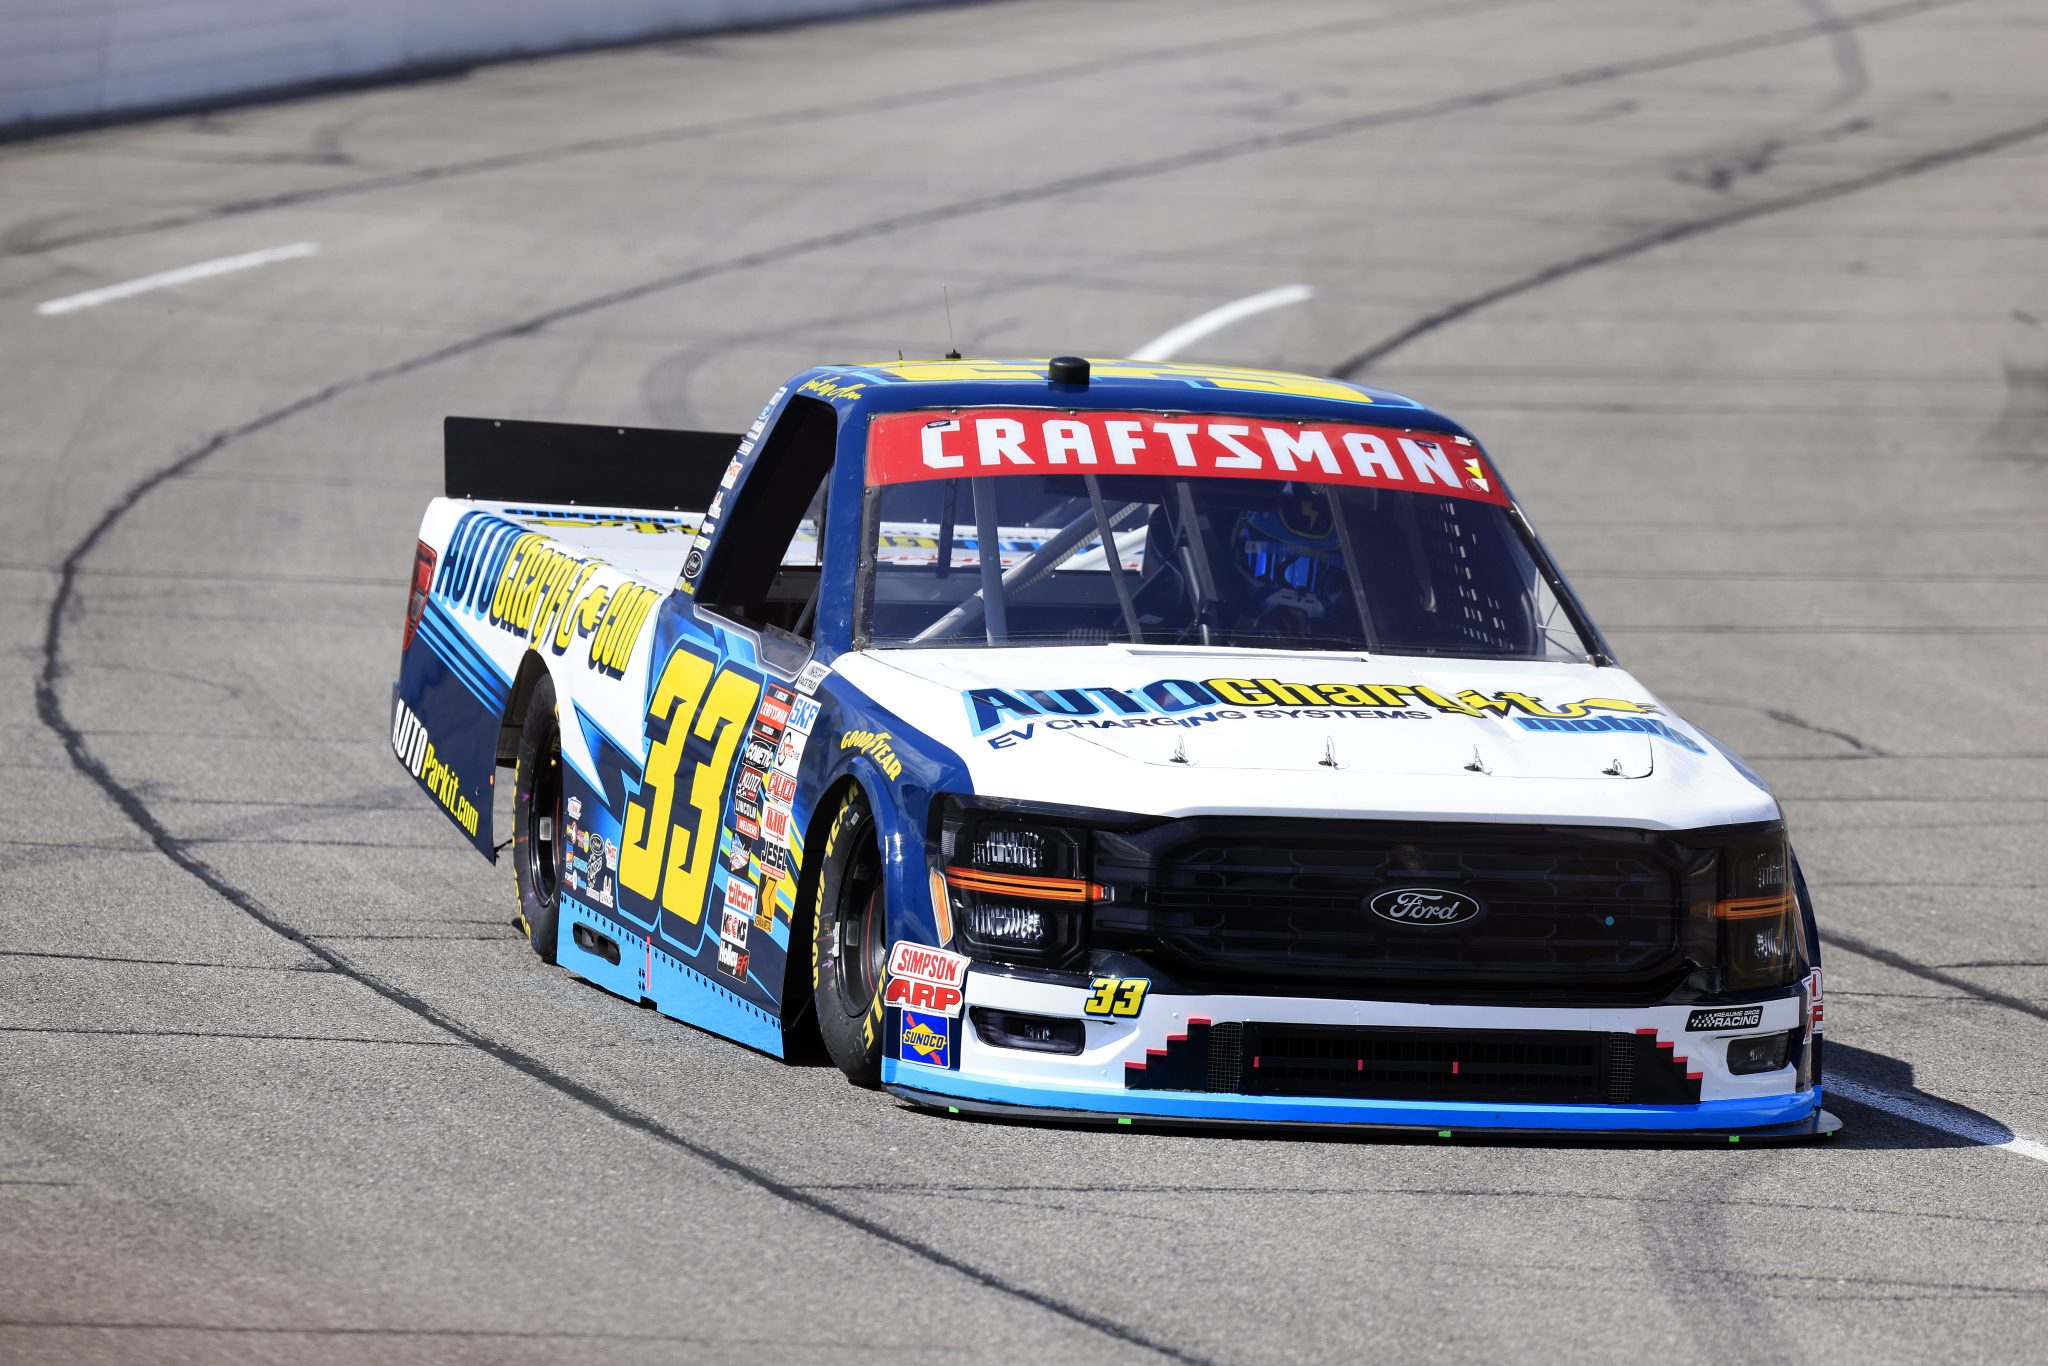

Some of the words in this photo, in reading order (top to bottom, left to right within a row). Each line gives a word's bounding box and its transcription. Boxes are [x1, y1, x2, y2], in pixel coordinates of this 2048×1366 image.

[921, 418, 1463, 488] CRAFTSMAN
[788, 698, 820, 730] SKF
[987, 723, 1034, 749] EV
[1045, 709, 1246, 730] CHARGING
[1254, 708, 1433, 720] SYSTEMS
[392, 698, 479, 837] AUTOParkit.com
[840, 730, 902, 782] GOODYEAR
[619, 648, 760, 925] 33
[741, 771, 761, 793] KLOTZ
[767, 771, 797, 801] CALICO
[735, 799, 757, 819] LINCOLN
[761, 840, 787, 872] JESEL
[1389, 892, 1461, 920] Ford
[898, 948, 960, 981] SIMPSON
[886, 978, 961, 1011] ARP
[1085, 977, 1150, 1016] 33
[1714, 1015, 1759, 1027] RACING
[904, 1030, 944, 1049] SUNOCO
